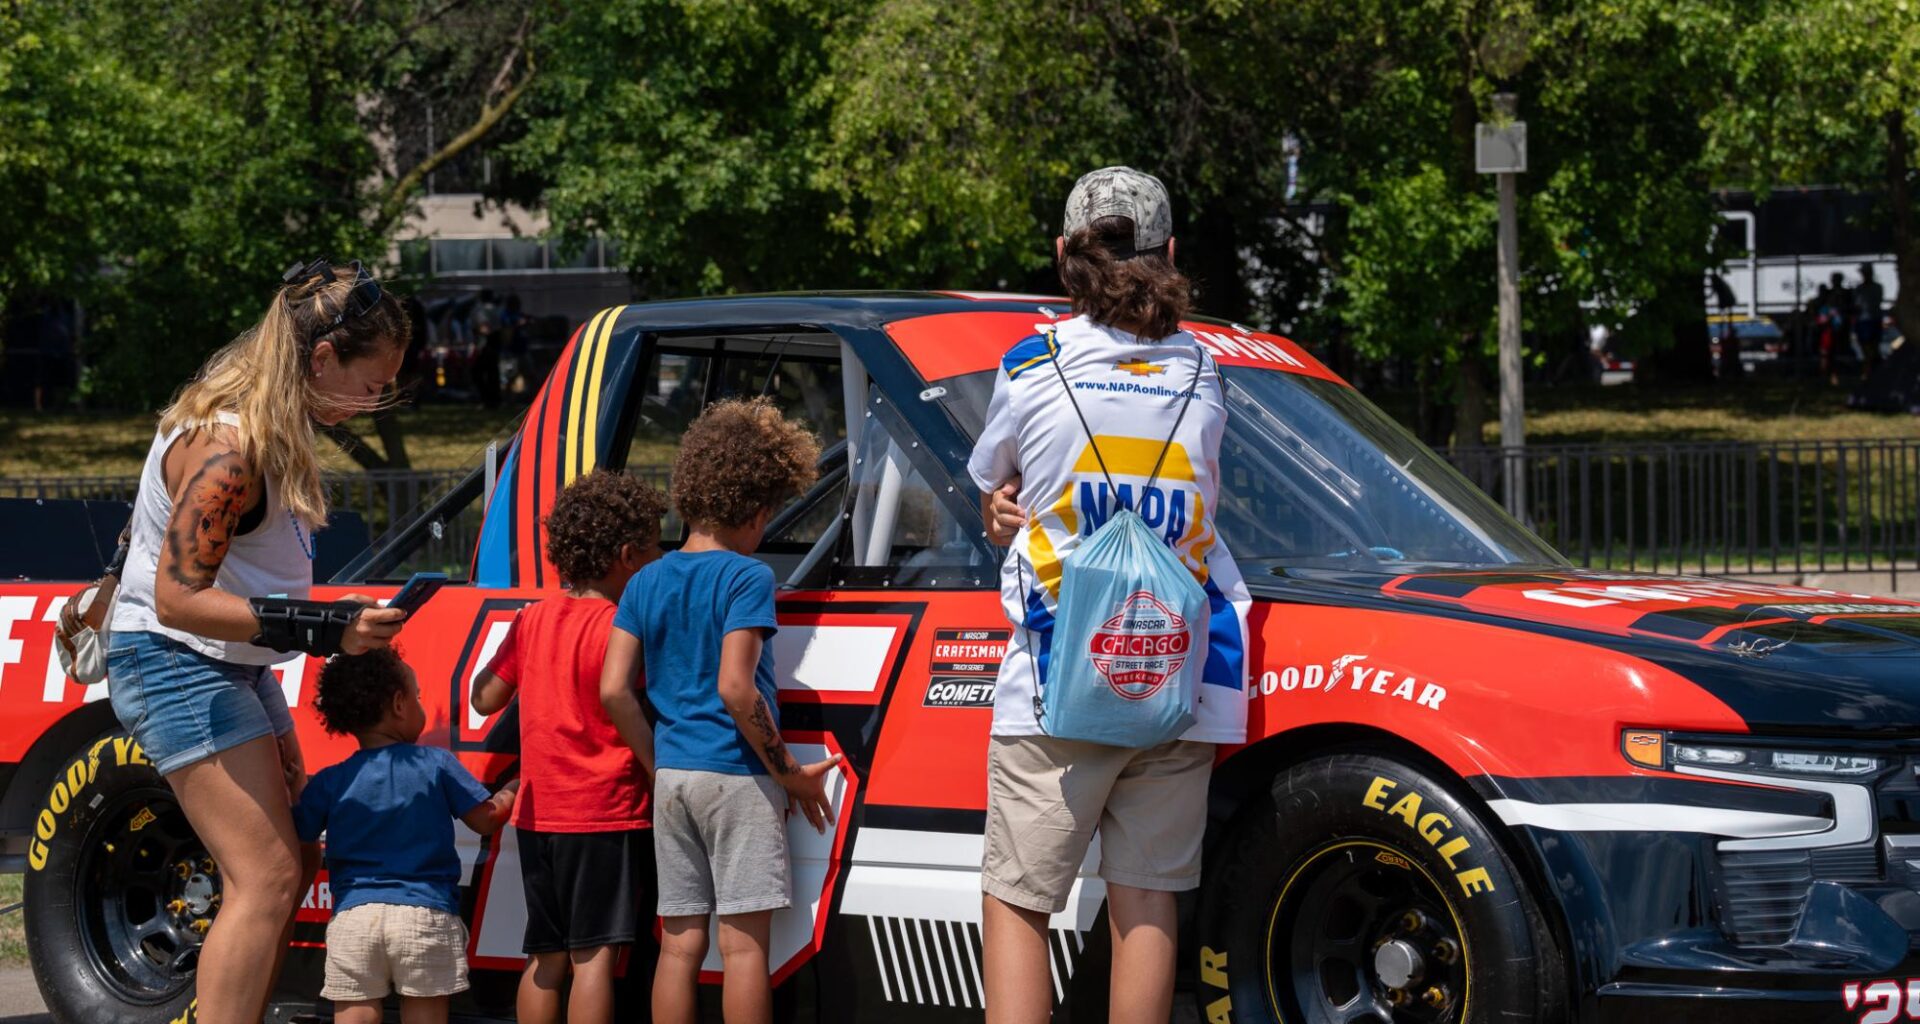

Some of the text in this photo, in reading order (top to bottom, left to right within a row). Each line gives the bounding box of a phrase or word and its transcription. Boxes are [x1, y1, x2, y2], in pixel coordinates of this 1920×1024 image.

[1074, 380, 1202, 401] www.NAPAonline.com
[1129, 619, 1166, 630] NASCAR
[935, 644, 1006, 658] CRAFTSMAN
[1101, 635, 1183, 655] CHICAGO
[1115, 660, 1164, 669] STREET RACE
[1115, 673, 1159, 683] WEEKEND
[1362, 776, 1496, 898] EAGLE
